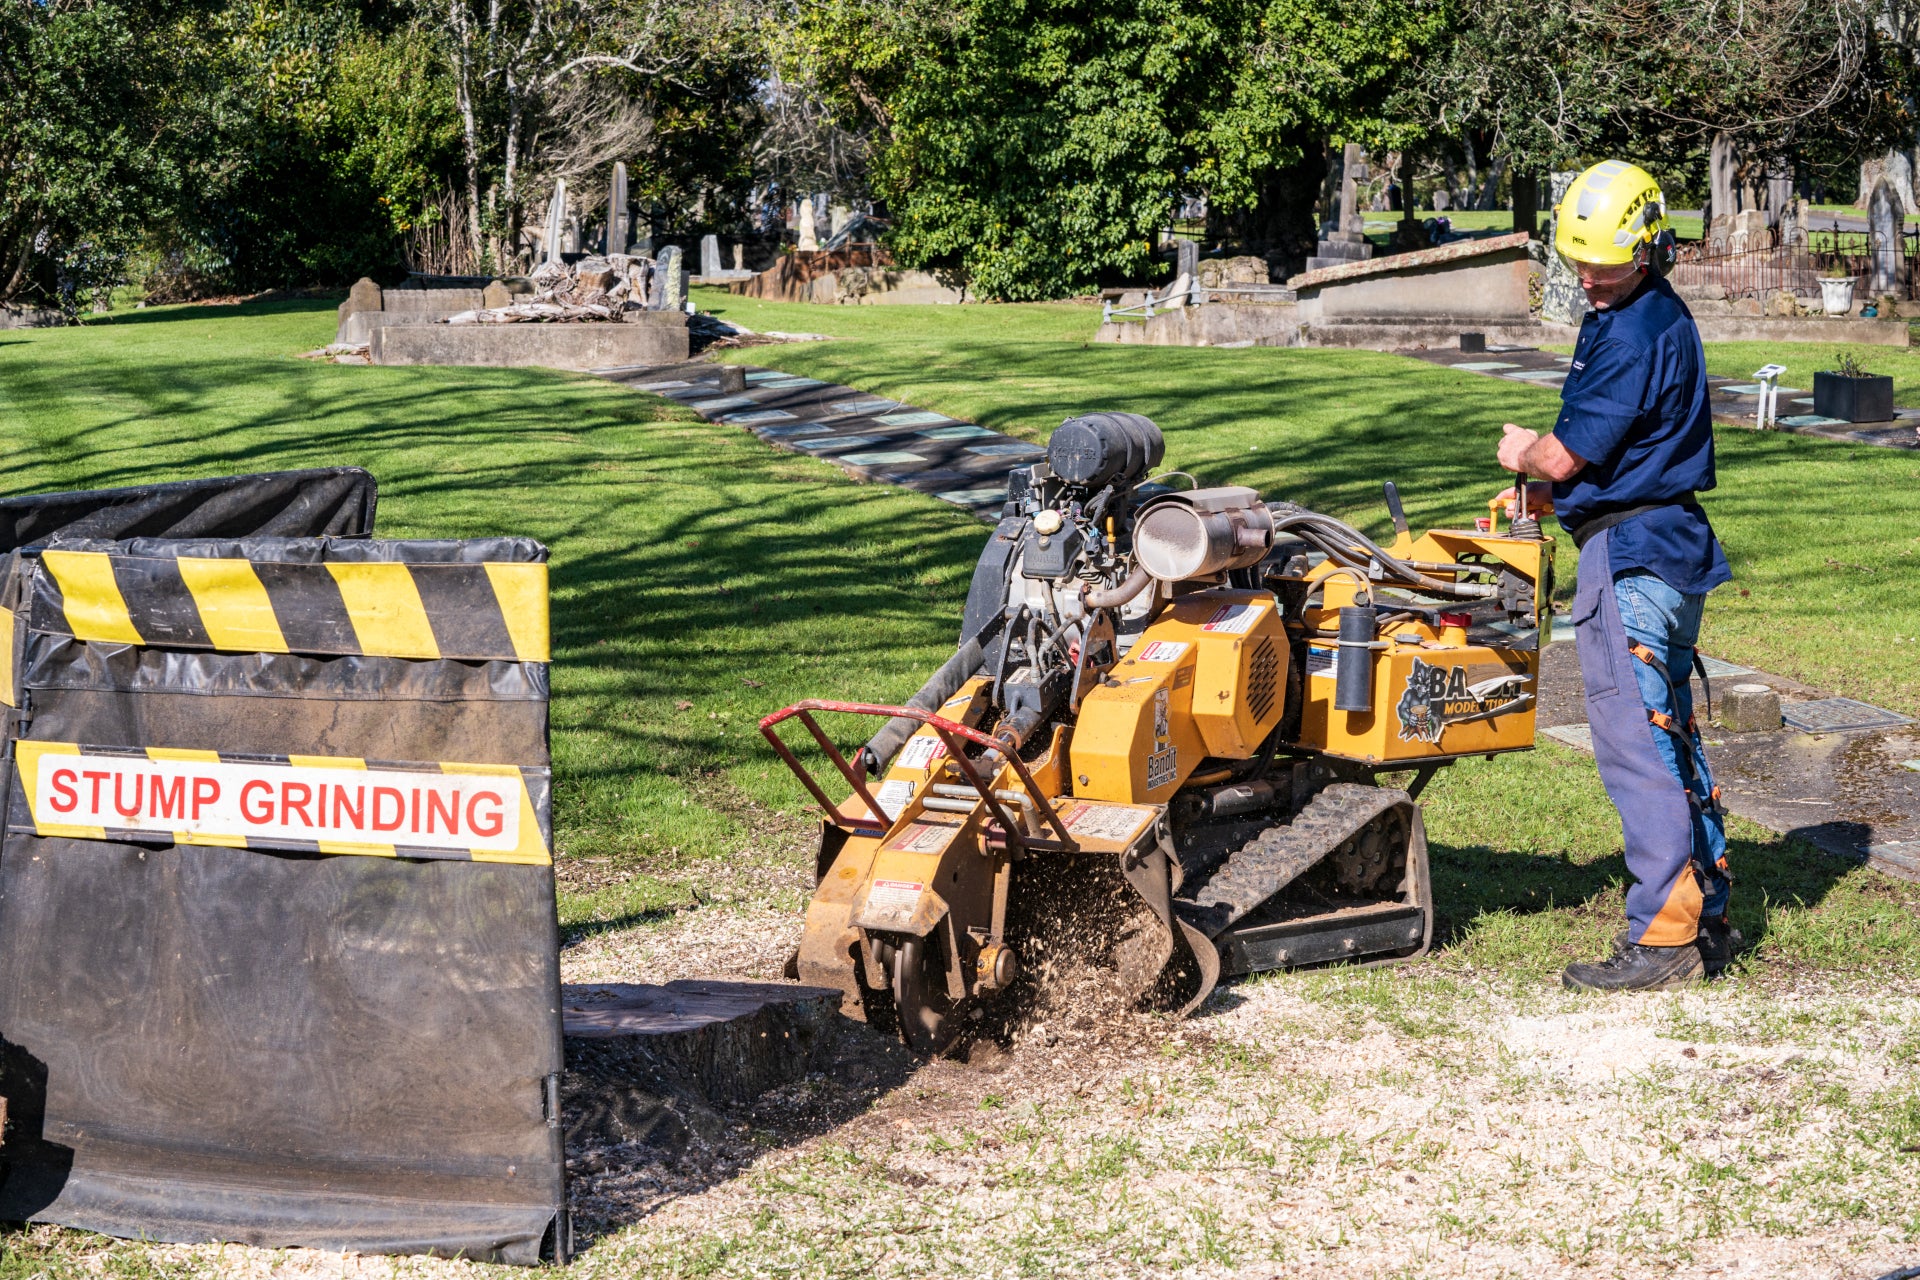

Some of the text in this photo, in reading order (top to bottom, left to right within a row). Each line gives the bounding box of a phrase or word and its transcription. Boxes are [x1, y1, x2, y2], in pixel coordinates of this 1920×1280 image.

[1148, 747, 1177, 779] Bandit
[49, 768, 503, 837] STUMP GRINDING
